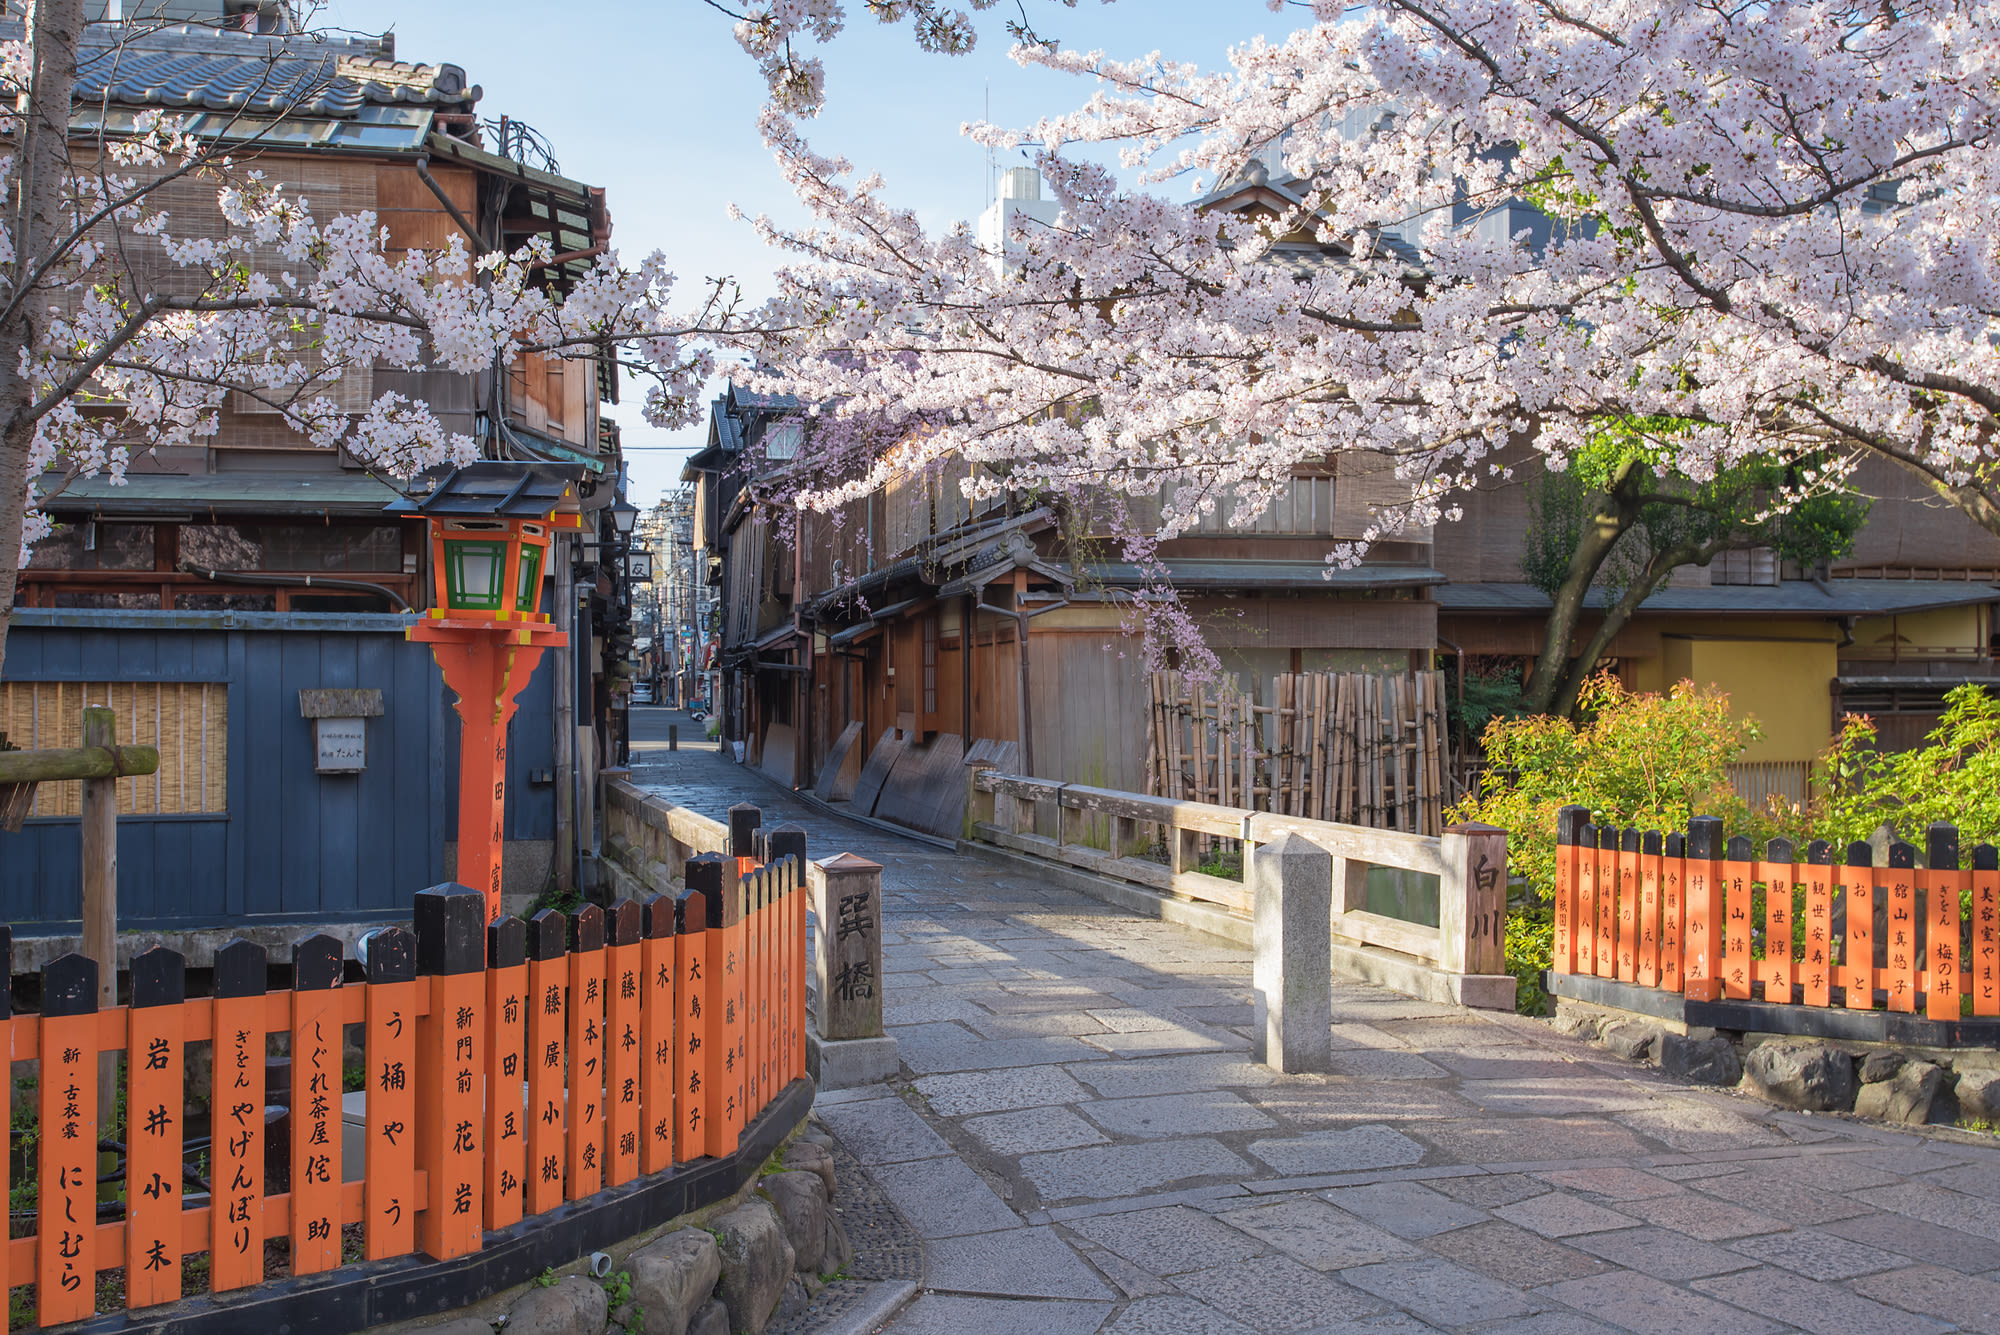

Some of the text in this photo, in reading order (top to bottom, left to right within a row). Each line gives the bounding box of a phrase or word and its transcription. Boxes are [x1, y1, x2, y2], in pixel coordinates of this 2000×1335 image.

[632, 560, 648, 577] 友
[835, 891, 874, 1001] 巽橋
[1471, 854, 1499, 947] 白川
[1581, 862, 1591, 960] 美の八重
[1622, 867, 1632, 967] みの家
[1666, 872, 1677, 974] 今藤長十郎
[1690, 874, 1704, 978] 村かみ
[1731, 877, 1745, 985] 片山清愛
[1771, 879, 1786, 987] 観世淳夫
[1811, 880, 1826, 989] 観世安寿子
[1853, 882, 1867, 990] おいと
[1981, 887, 1994, 998] 美容室やまと
[1937, 944, 1953, 995] 梅の井
[500, 994, 519, 1198] 前田豆弘
[541, 984, 562, 1184] 藤廣小桃
[582, 977, 599, 1171] 岸本フク愛
[619, 971, 636, 1157] 藤本君彌
[654, 963, 671, 1143] 木村咲
[143, 1038, 172, 1272] 岩井小末
[380, 1012, 405, 1225] う桶やう
[59, 1167, 83, 1291] にしむら
